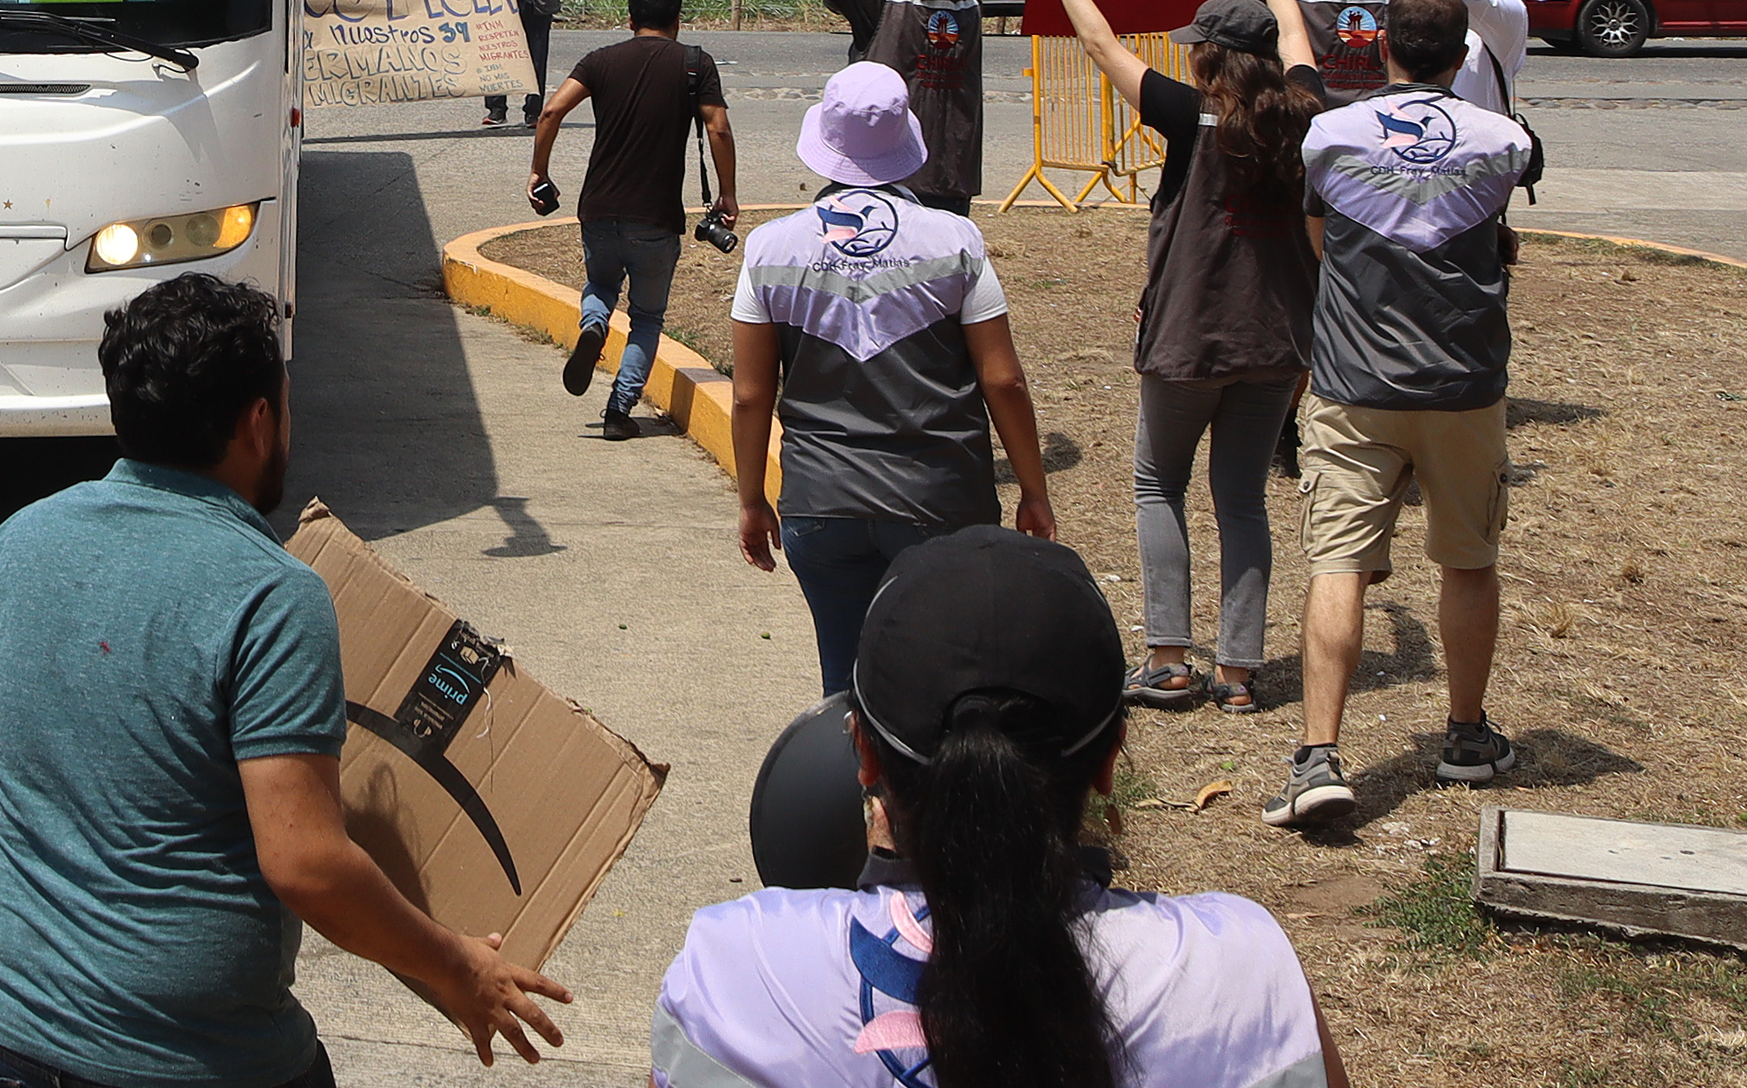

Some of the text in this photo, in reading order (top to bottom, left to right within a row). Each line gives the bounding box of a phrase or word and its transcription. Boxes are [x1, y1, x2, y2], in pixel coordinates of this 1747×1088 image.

[329, 22, 436, 45] nuestros
[438, 21, 471, 43] 39
[304, 42, 469, 81] ERMANOS
[479, 49, 530, 62] MIGRANTES
[309, 70, 467, 107] MIGRANTES
[428, 673, 469, 706] prime
